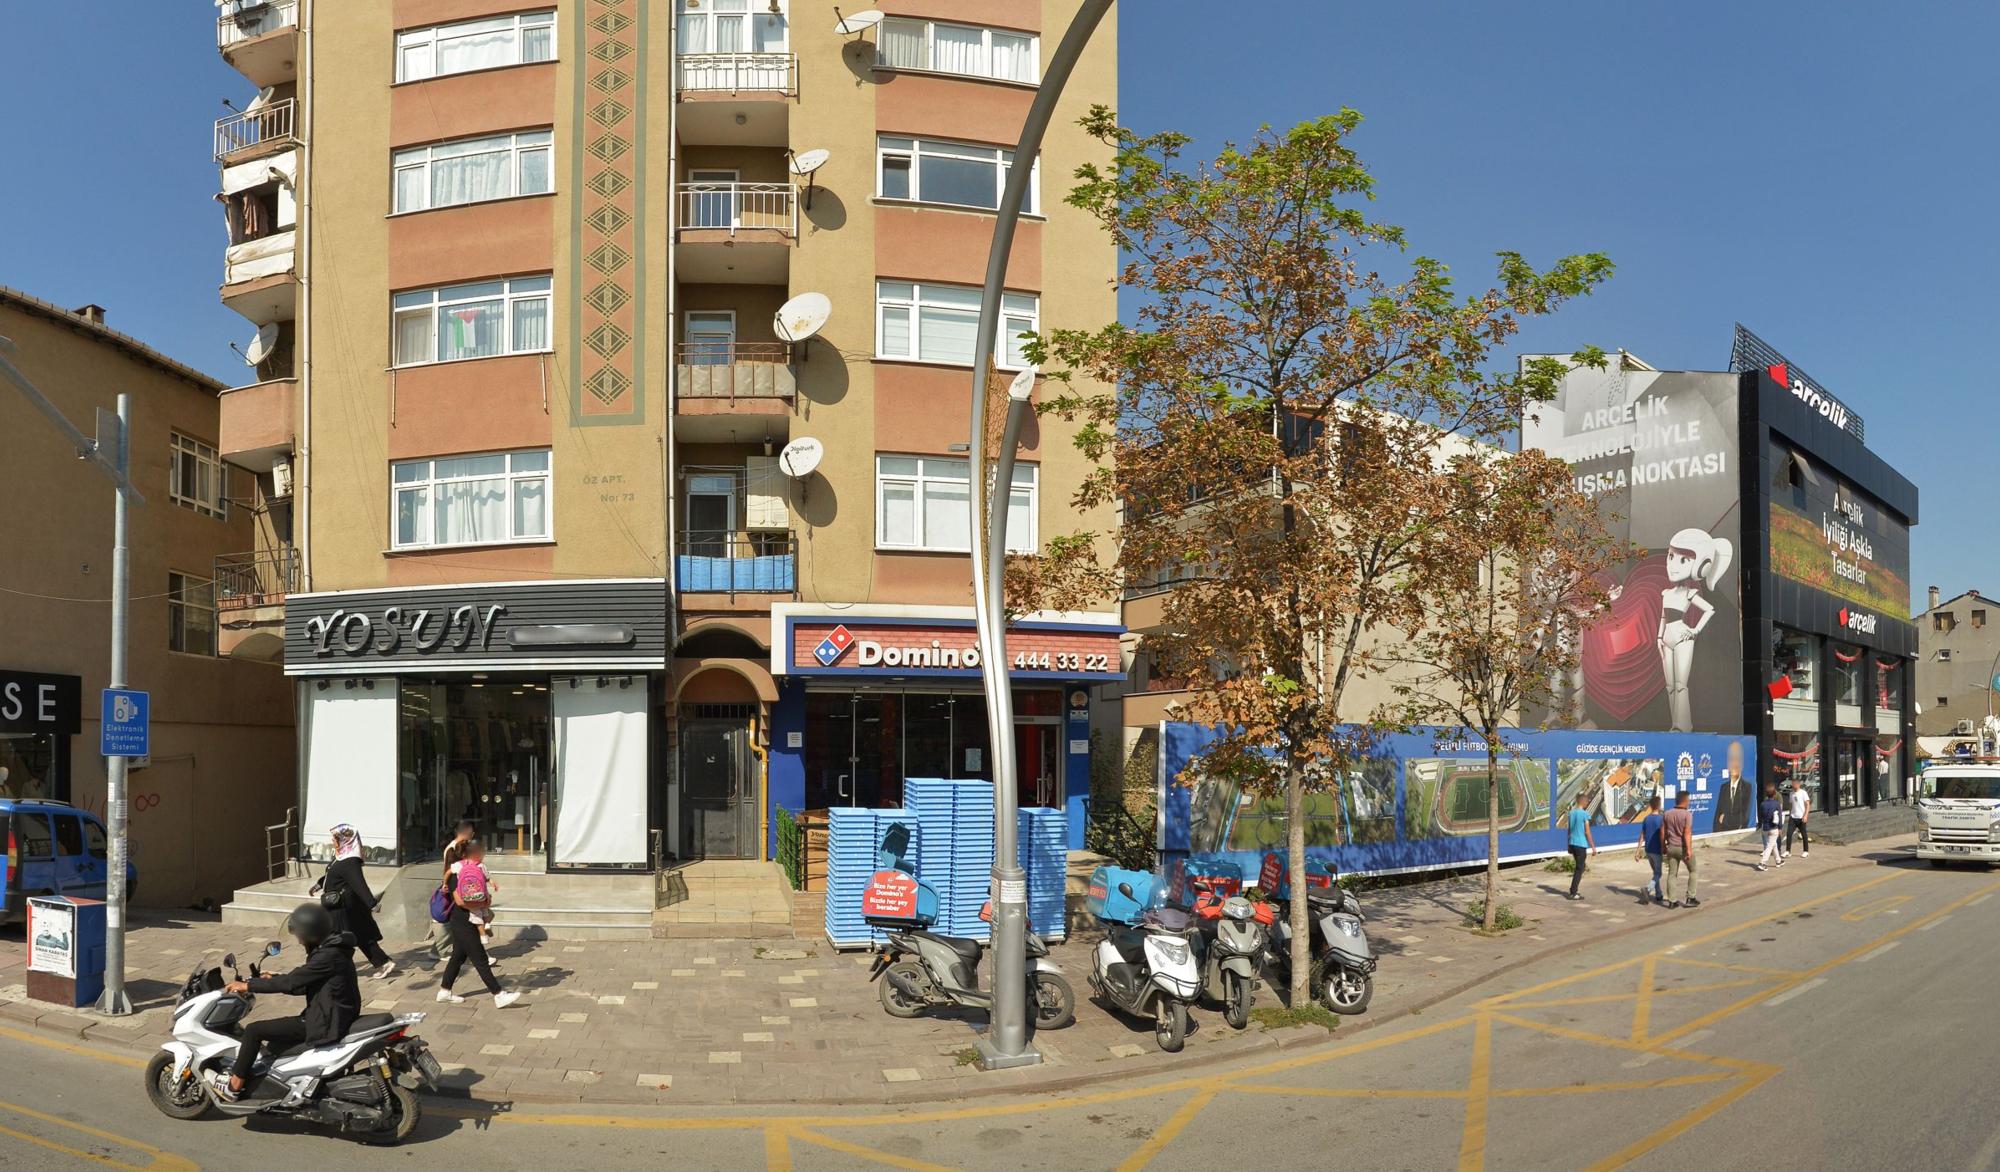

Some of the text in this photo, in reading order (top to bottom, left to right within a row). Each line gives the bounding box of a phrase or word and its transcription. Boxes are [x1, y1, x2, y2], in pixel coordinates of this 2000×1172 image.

[1581, 394, 1670, 432] ARÇELİK
[1631, 451, 1726, 487] NOKTASI
[1823, 511, 1873, 561] İyiliği Aşkla
[1831, 550, 1867, 585] Tasarlar
[304, 602, 507, 657] YOSUN
[1848, 611, 1877, 635] arçelik
[858, 639, 1108, 671] Domino' 444 33 22
[105, 733, 145, 742] Denetleme
[106, 724, 144, 733] Elektronik
[111, 743, 140, 751] Sistemi
